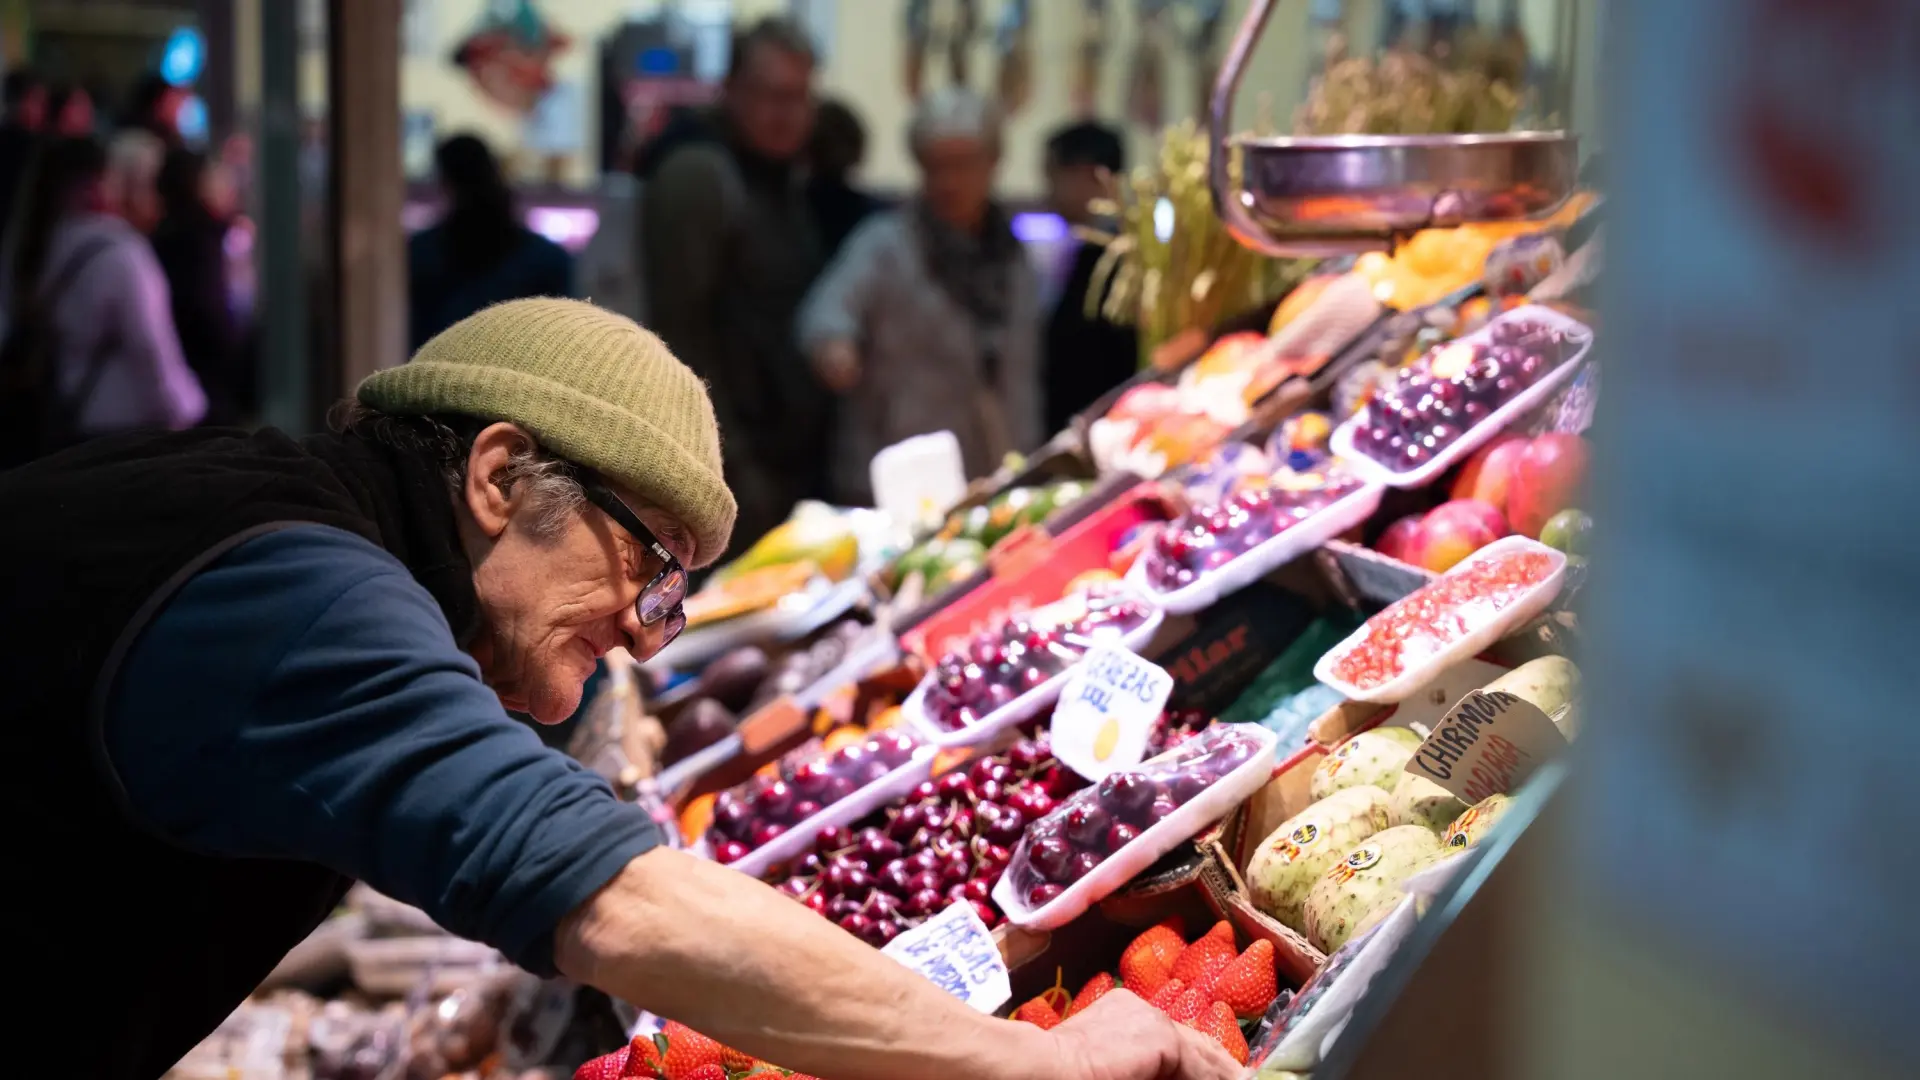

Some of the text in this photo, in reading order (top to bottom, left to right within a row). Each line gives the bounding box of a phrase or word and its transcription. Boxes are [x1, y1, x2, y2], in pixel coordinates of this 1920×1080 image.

[1086, 649, 1160, 703] CEREZAS
[1415, 691, 1519, 780] CHIRIMOYA
[929, 914, 1001, 985] FRESAS
